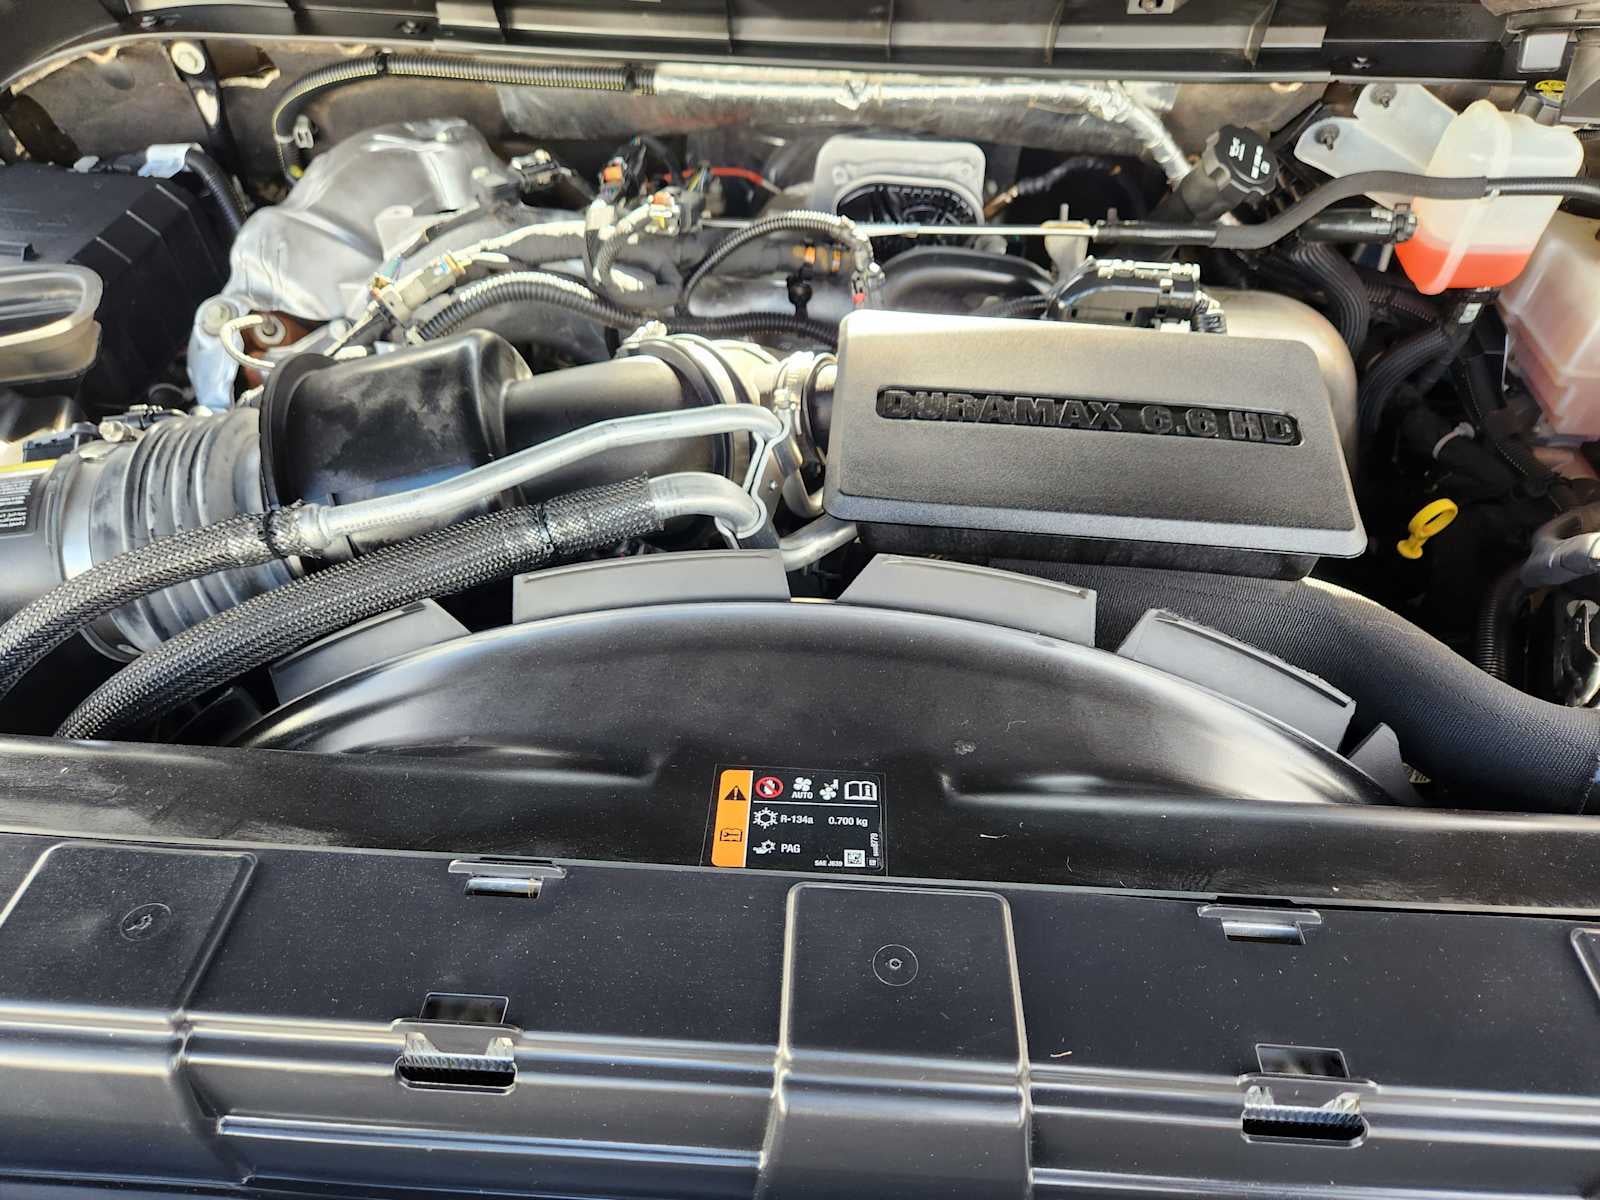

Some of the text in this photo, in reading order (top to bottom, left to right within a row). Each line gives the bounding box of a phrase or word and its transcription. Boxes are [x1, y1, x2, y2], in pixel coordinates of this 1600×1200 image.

[882, 389, 1297, 445] DURAMAX 6.6 HD
[791, 791, 813, 800] AUTO
[780, 814, 868, 827] R-134a 0.700 kg
[780, 843, 801, 853] PAG
